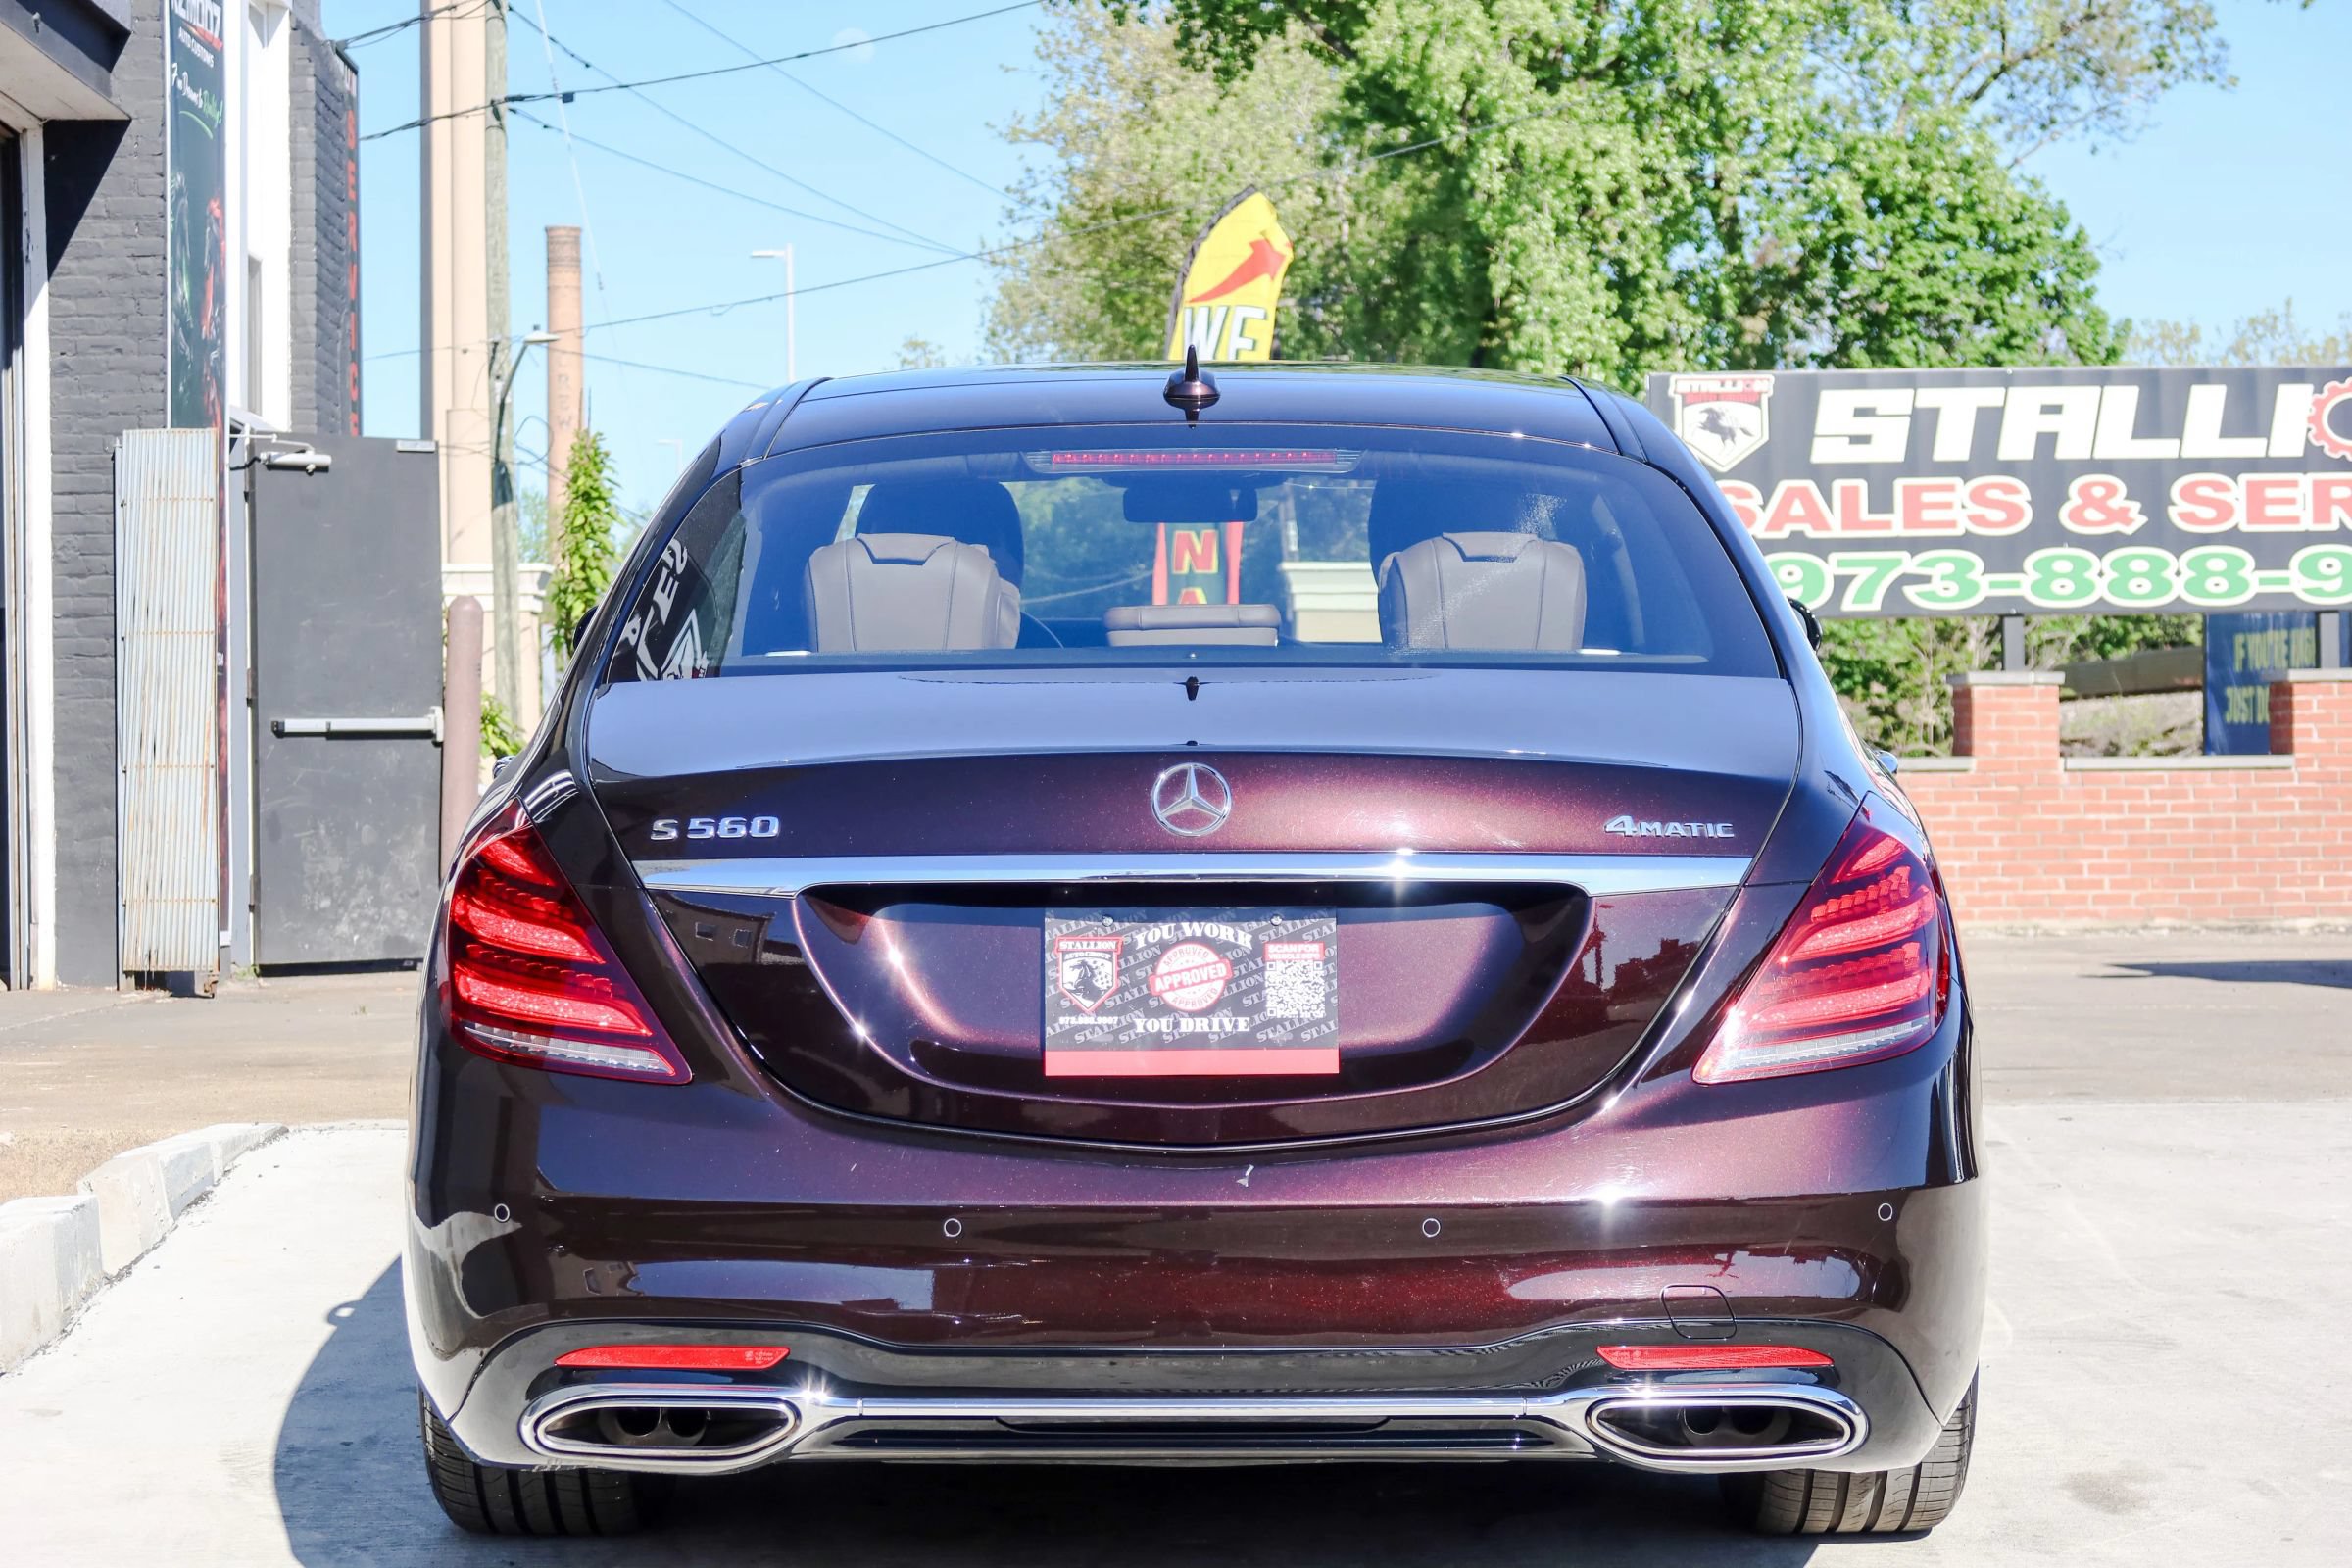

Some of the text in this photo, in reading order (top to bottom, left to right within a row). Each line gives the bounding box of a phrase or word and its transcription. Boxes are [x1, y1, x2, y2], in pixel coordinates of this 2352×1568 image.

[1716, 475, 2034, 538] SALES
[2058, 474, 2148, 535] &
[650, 815, 781, 841] S 560
[1604, 815, 1735, 839] 4MATIC
[1058, 941, 1117, 950] STALLION
[1136, 923, 1177, 951] YOU
[1181, 921, 1253, 951] WORK
[1085, 951, 1112, 959] GROUP
[1163, 946, 1210, 967] APPROVED
[1268, 944, 1319, 953] SCAN FOR
[1154, 962, 1228, 992] APPROVED
[1171, 986, 1219, 1010] APPROVED
[1133, 1018, 1174, 1033] YOU
[1179, 1017, 1250, 1032] DRIVE
